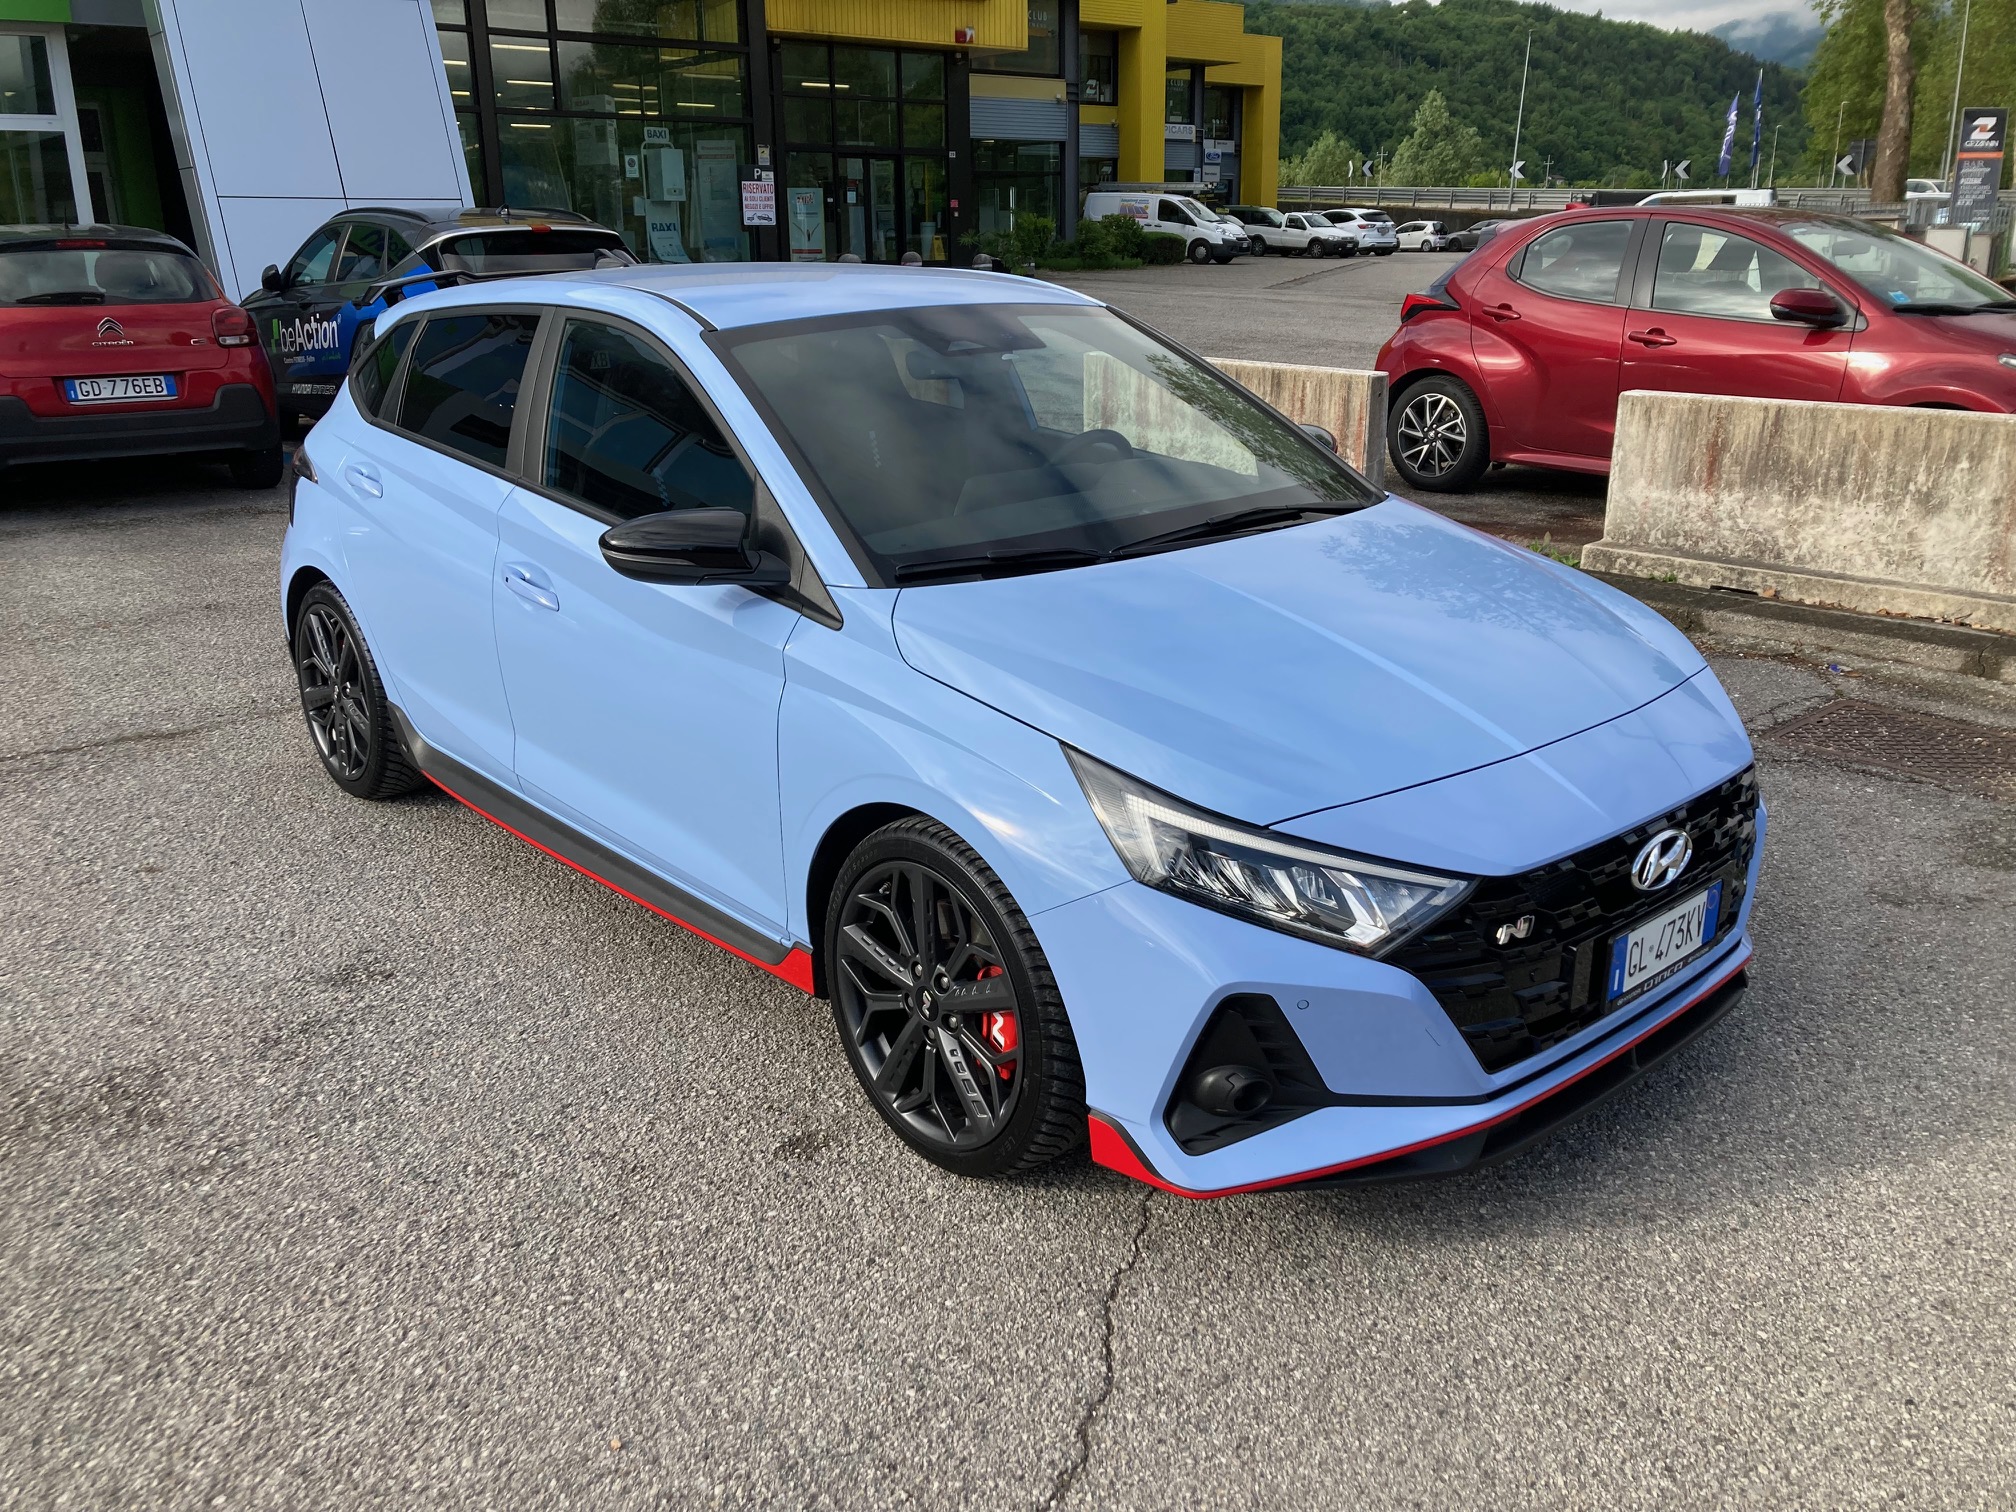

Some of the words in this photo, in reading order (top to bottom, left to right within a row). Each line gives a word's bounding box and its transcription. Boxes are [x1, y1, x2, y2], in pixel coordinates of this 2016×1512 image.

[646, 129, 667, 139] BAXI
[754, 168, 761, 180] P
[743, 183, 773, 194] RISERVATO
[651, 223, 676, 232] BAXI
[279, 313, 339, 352] beAction
[107, 378, 164, 396] 776EB
[1655, 902, 1706, 961] 473KV
